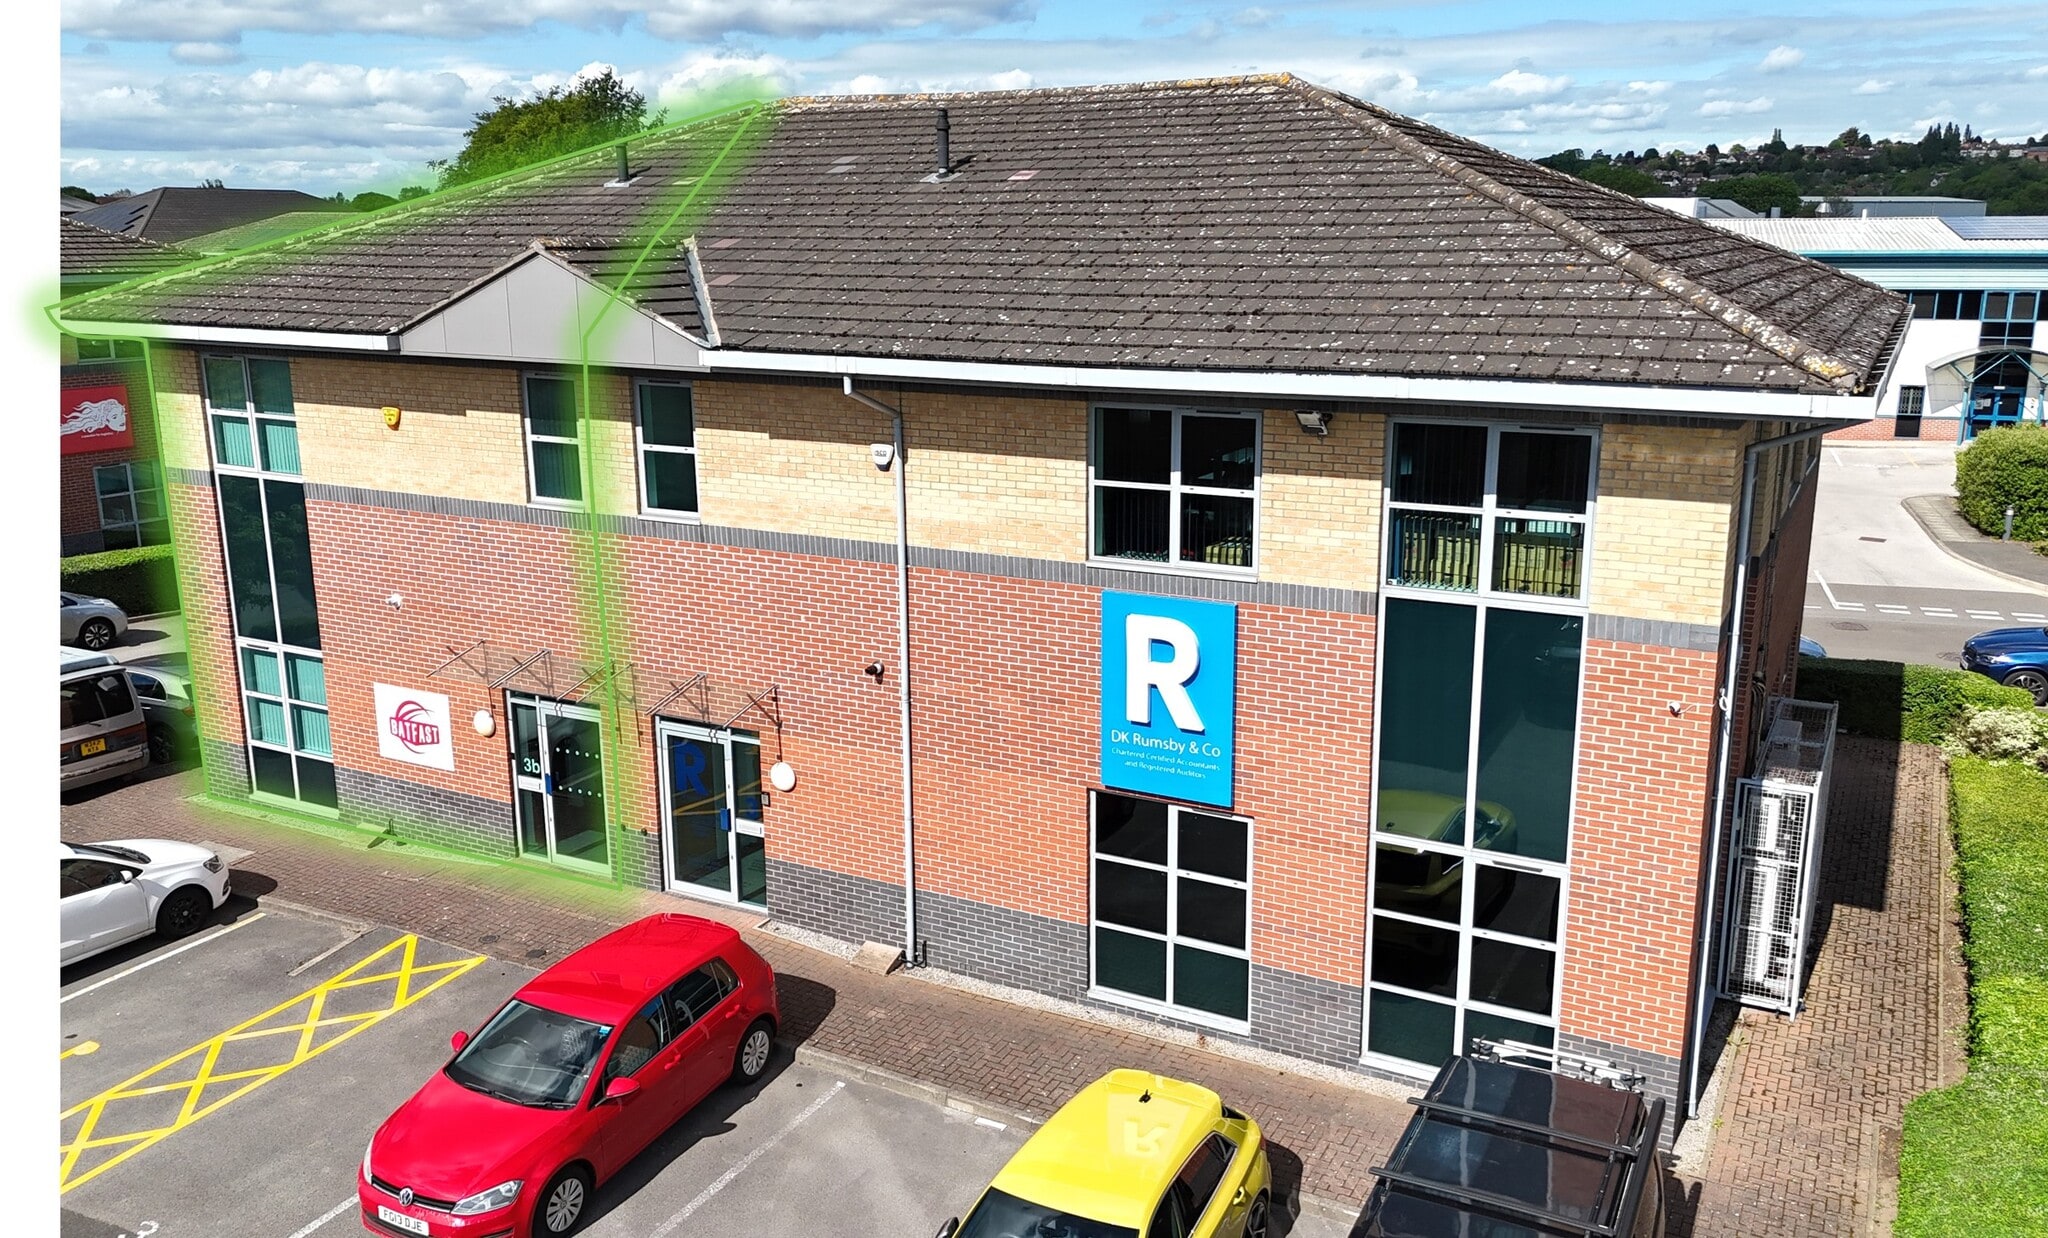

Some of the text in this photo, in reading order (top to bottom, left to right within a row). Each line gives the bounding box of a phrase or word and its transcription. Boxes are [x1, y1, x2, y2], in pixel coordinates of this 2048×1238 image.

[1125, 613, 1205, 733] R
[391, 719, 438, 744] BATFAST
[1111, 729, 1221, 758] DK Rumsby & Co
[523, 757, 541, 774] 3b
[674, 740, 709, 796] R
[1111, 747, 1221, 771] Chartered Certified Accountants
[1124, 760, 1206, 779] and Registered Auditors
[383, 1209, 423, 1232] FG13 DJE
